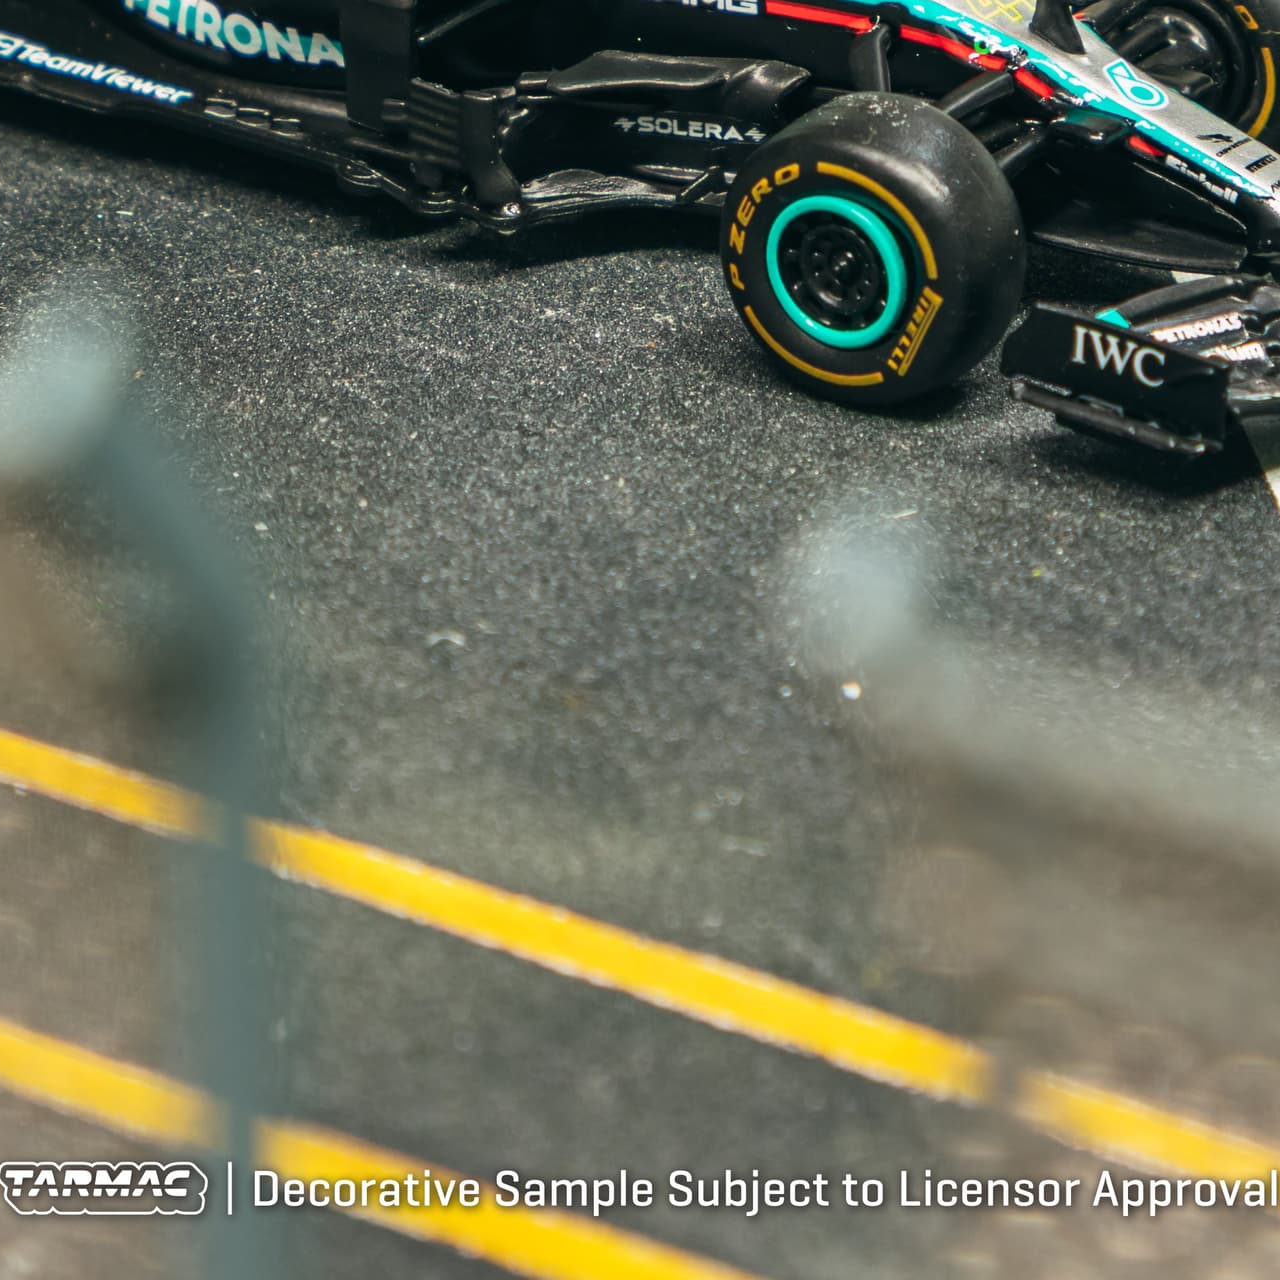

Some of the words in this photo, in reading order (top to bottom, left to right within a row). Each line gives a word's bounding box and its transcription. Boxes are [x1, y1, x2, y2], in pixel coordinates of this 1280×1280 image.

[17, 41, 194, 105] TeamViewer
[637, 116, 744, 143] SOLERA
[728, 162, 801, 256] ZERO
[728, 263, 746, 291] P
[1071, 324, 1166, 389] IWC
